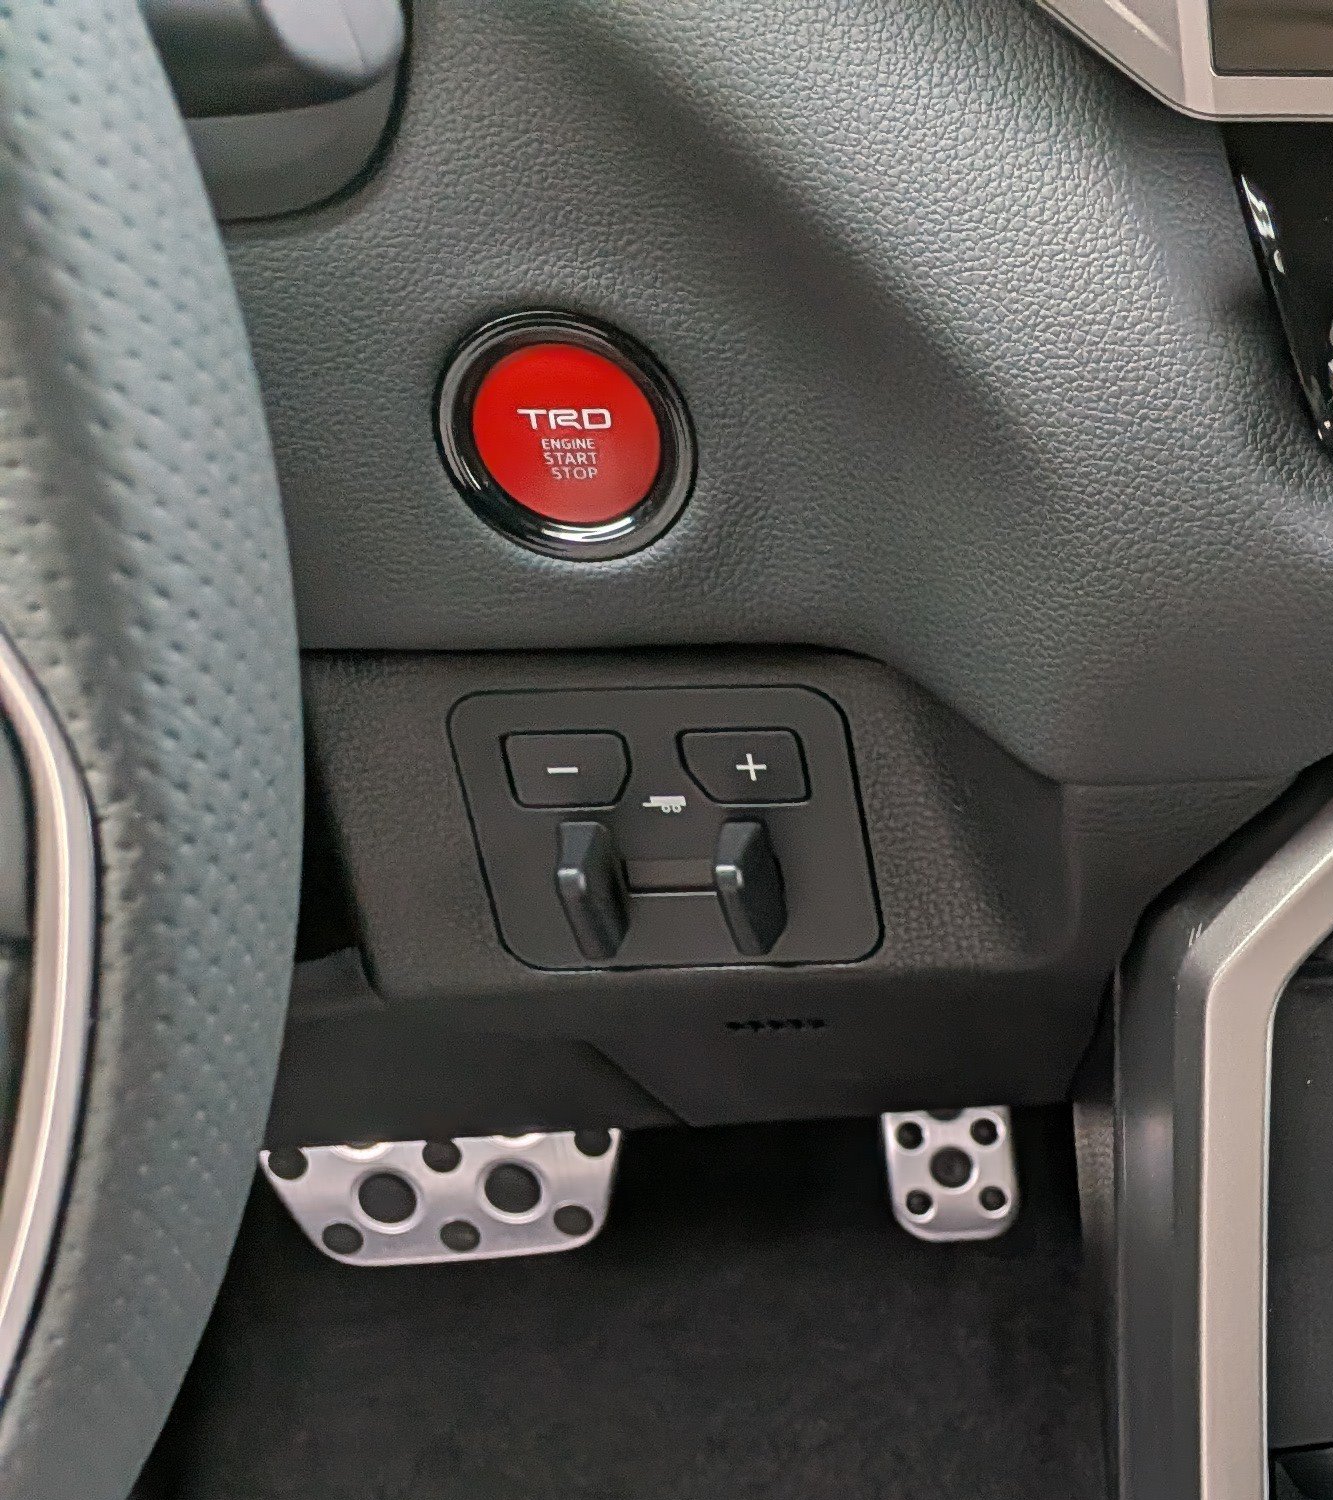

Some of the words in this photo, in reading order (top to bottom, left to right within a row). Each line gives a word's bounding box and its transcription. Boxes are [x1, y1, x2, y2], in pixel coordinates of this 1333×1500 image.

[517, 408, 612, 430] TRD
[541, 438, 596, 450] ENGINE
[543, 452, 598, 465] START
[551, 466, 598, 480] STOP
